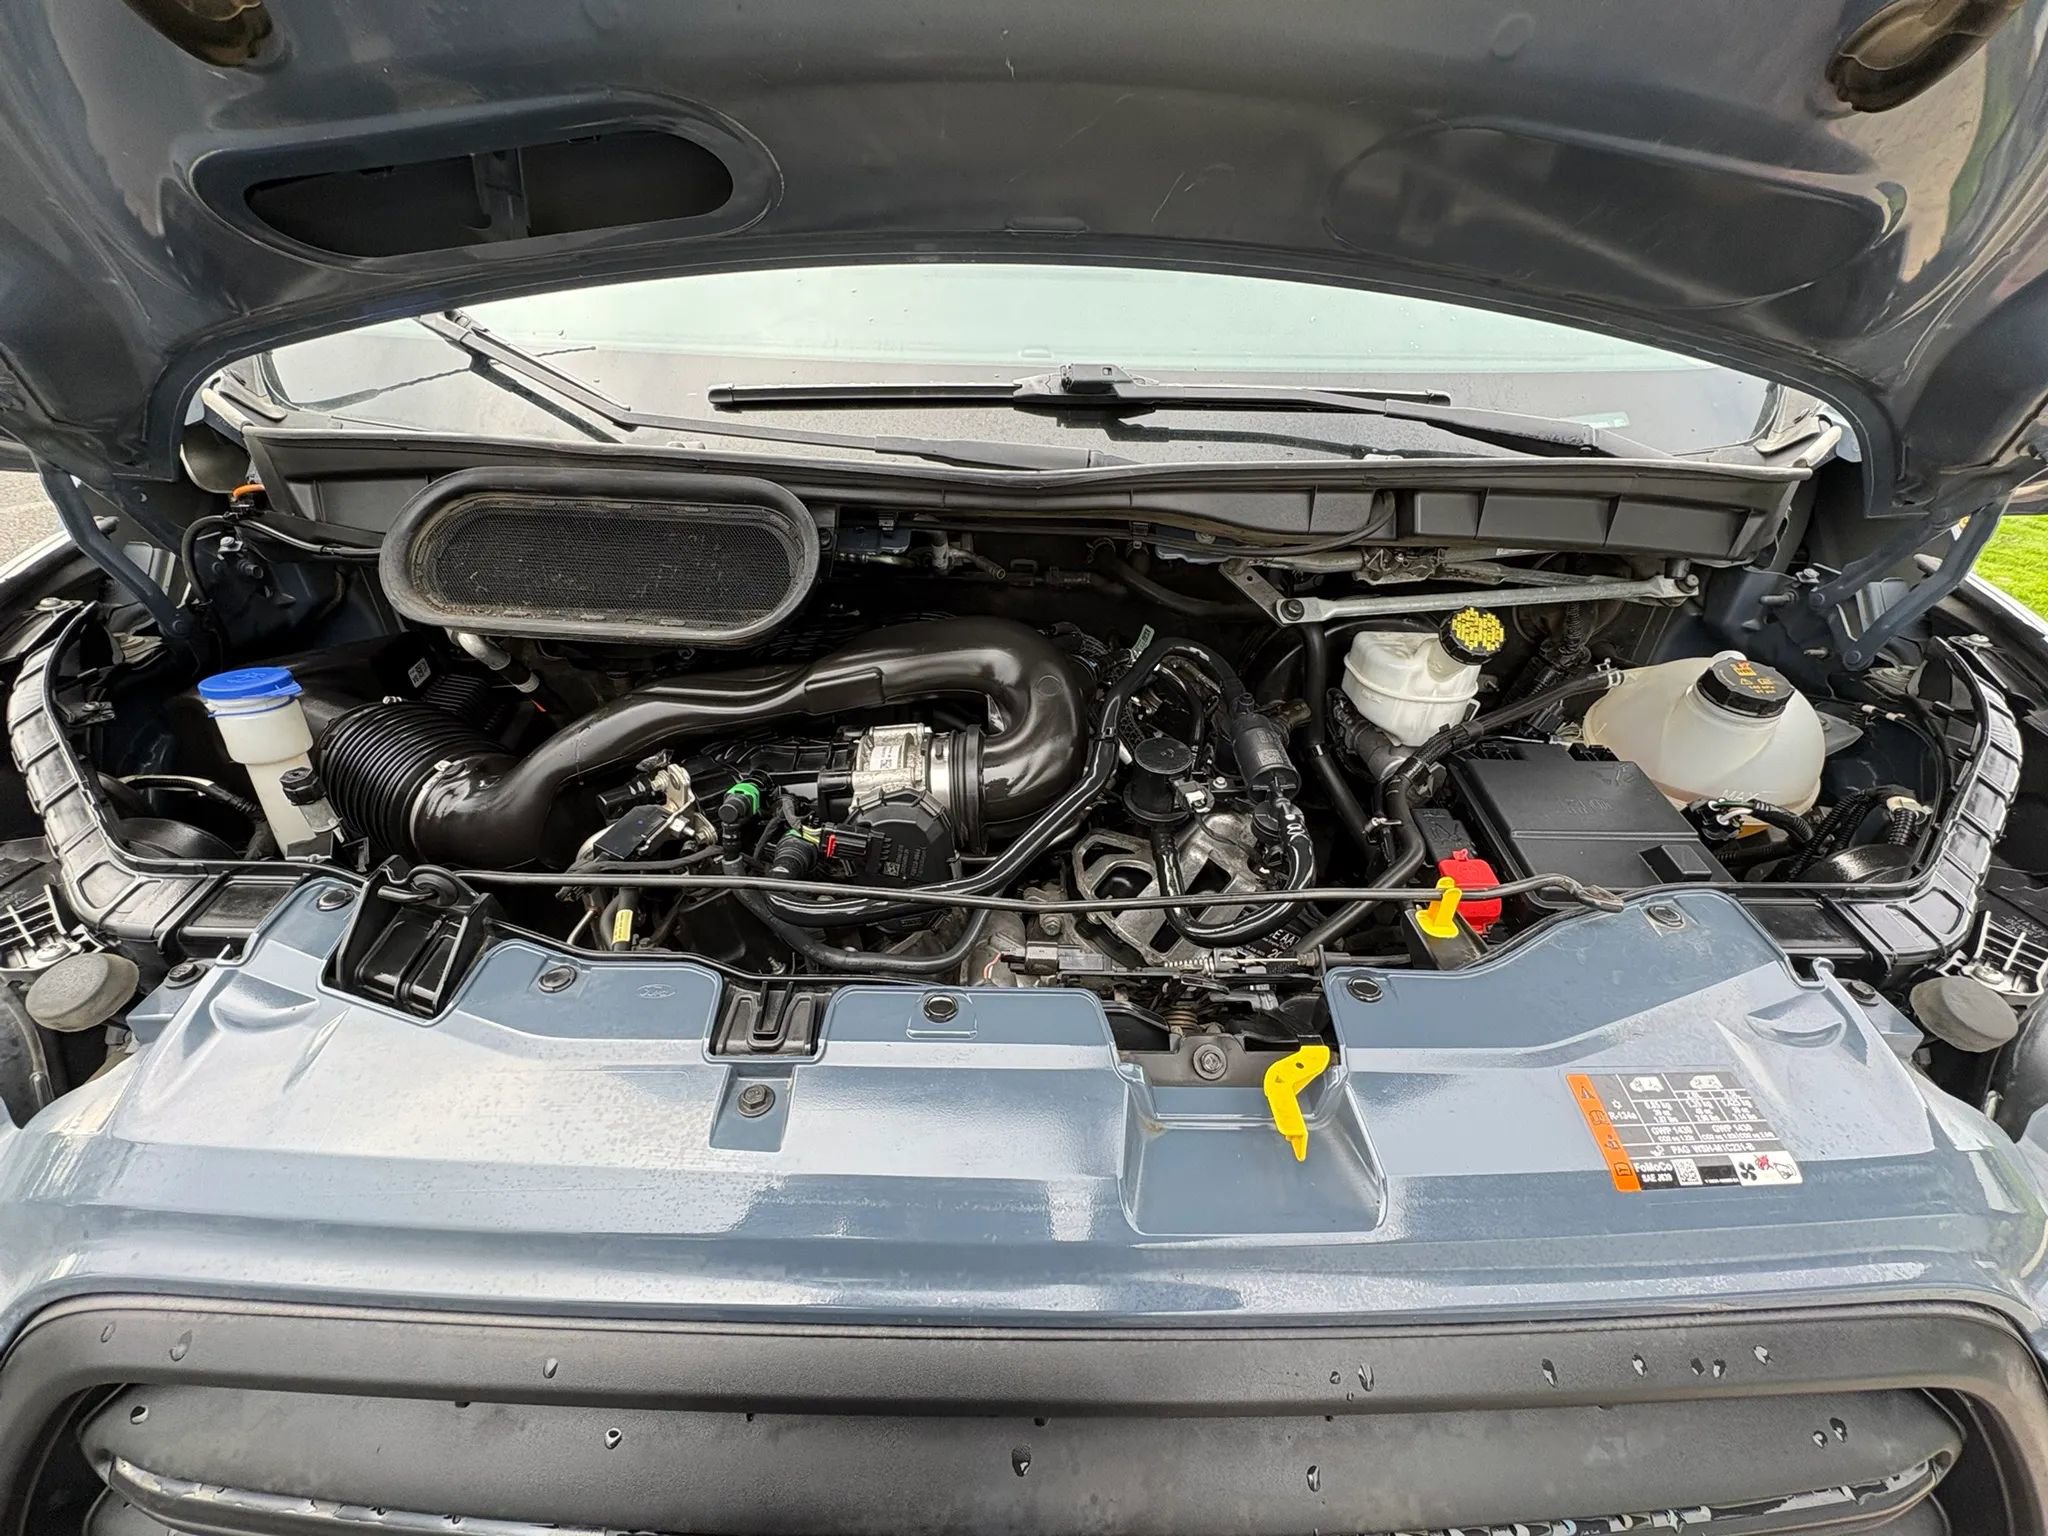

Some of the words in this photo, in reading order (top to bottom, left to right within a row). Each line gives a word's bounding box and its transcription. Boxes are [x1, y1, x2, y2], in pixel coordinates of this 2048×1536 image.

[1607, 1110, 1638, 1121] R-134a
[1651, 1126, 1672, 1136] GWP
[1672, 1125, 1694, 1135] 1430
[1711, 1124, 1732, 1134] GWP
[1732, 1123, 1754, 1133] 1430
[1670, 1144, 1691, 1154] PAG
[1634, 1162, 1673, 1173] FoMoCo
[1641, 1173, 1657, 1183] SAE
